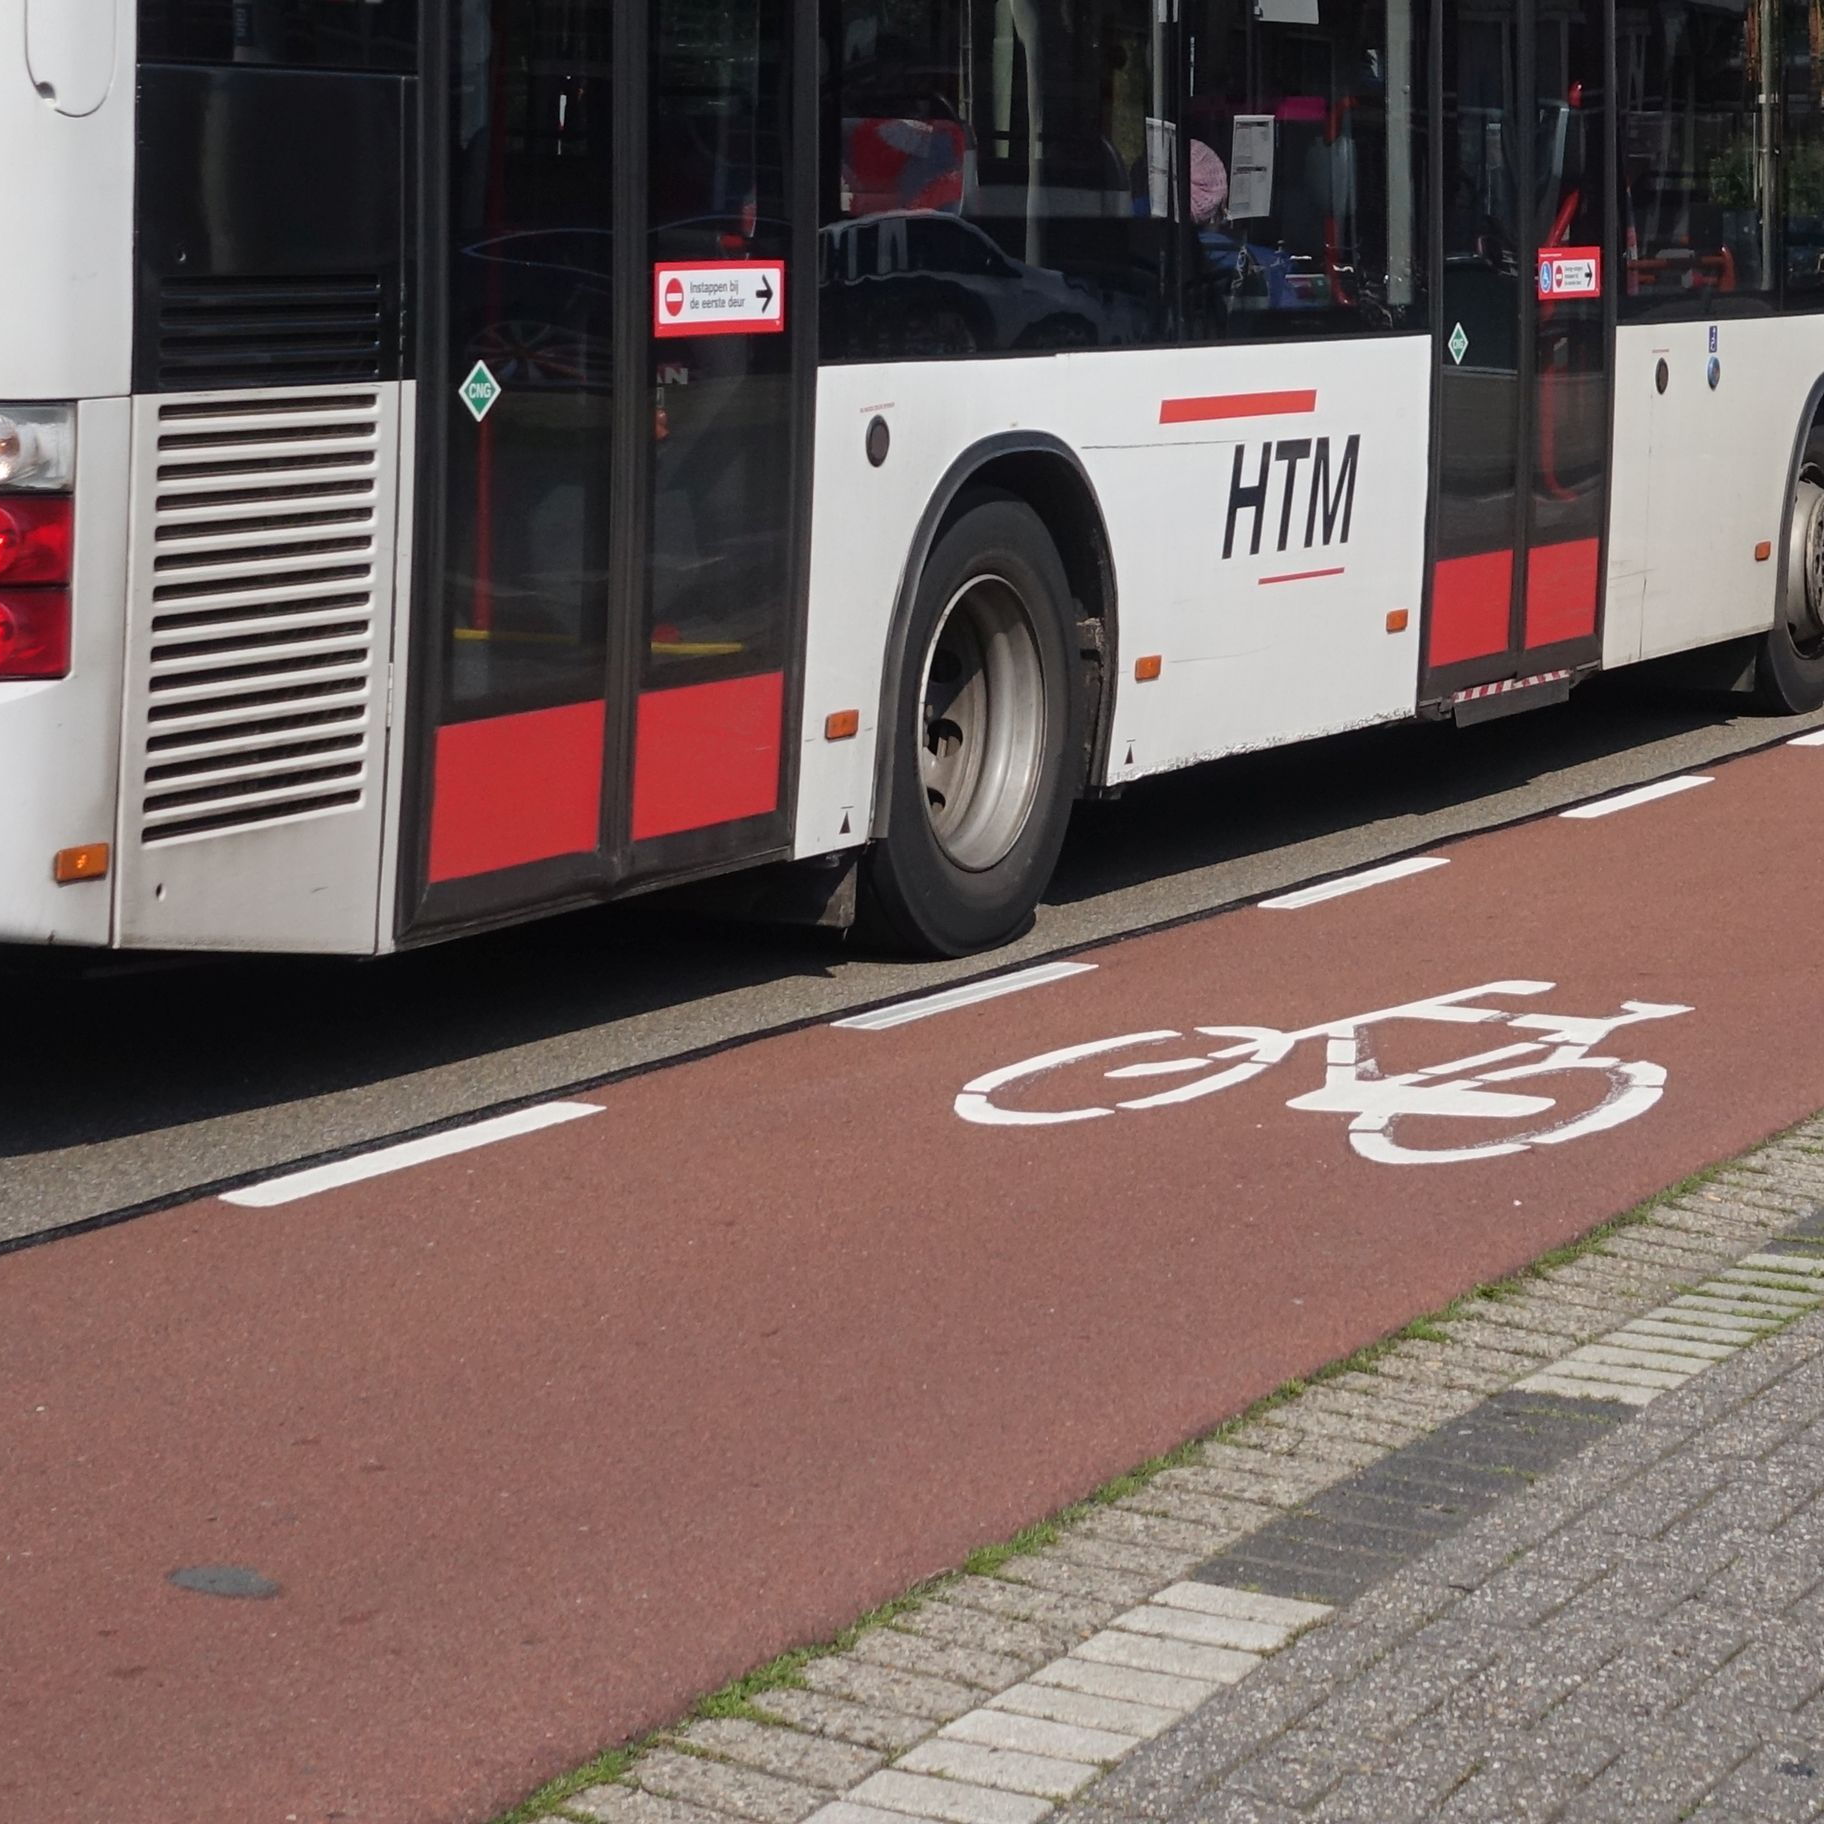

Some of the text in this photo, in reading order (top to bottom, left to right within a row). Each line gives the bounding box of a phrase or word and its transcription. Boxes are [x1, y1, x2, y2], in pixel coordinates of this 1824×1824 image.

[690, 280, 739, 296] Instappen bij
[689, 296, 746, 310] de eerste deur
[468, 382, 492, 399] CNG
[1221, 433, 1361, 560] HTM
